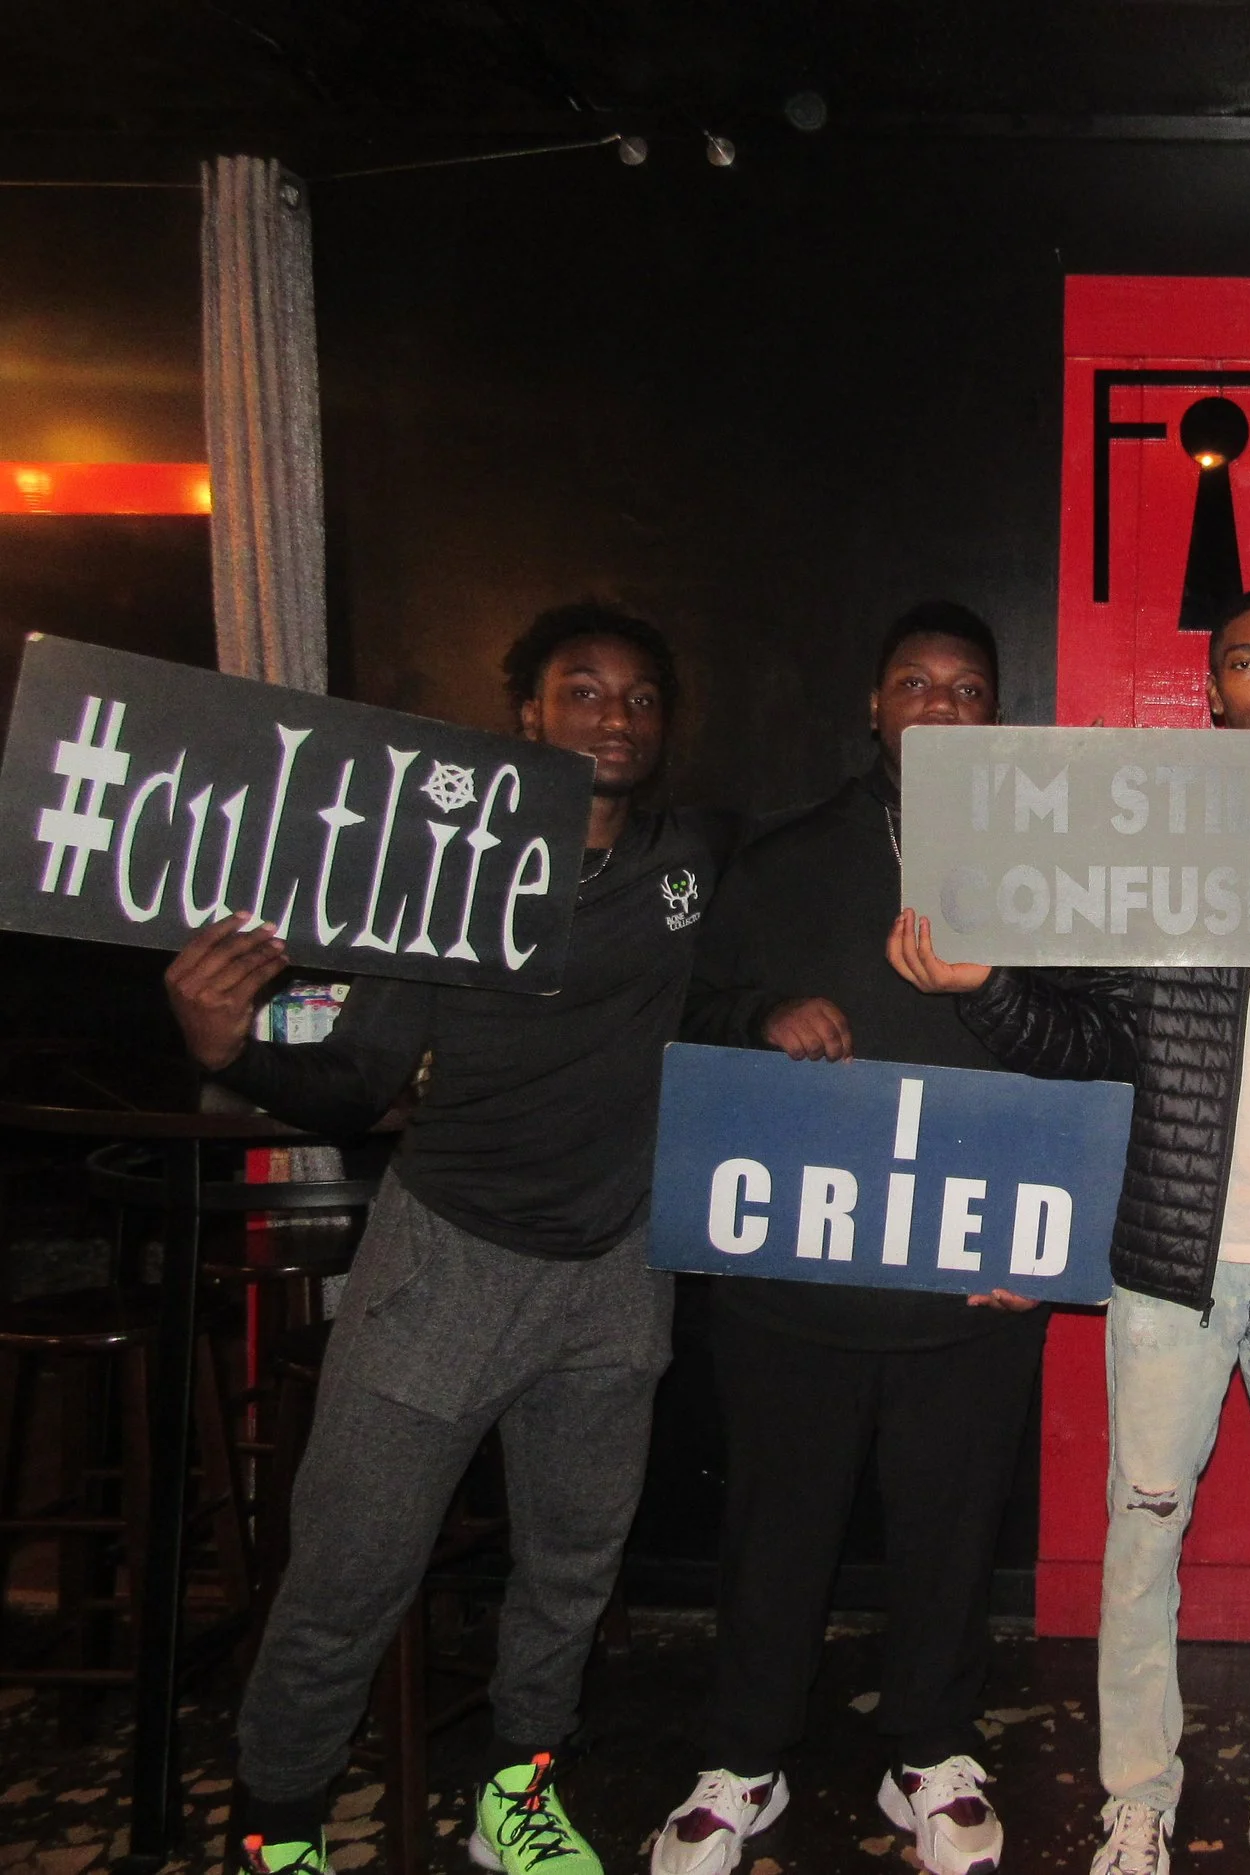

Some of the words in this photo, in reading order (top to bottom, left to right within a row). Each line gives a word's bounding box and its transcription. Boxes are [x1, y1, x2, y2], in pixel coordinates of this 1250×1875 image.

[970, 762, 1070, 835] I'M
[893, 1077, 924, 1160] I
[707, 1157, 1074, 1277] CRIED
